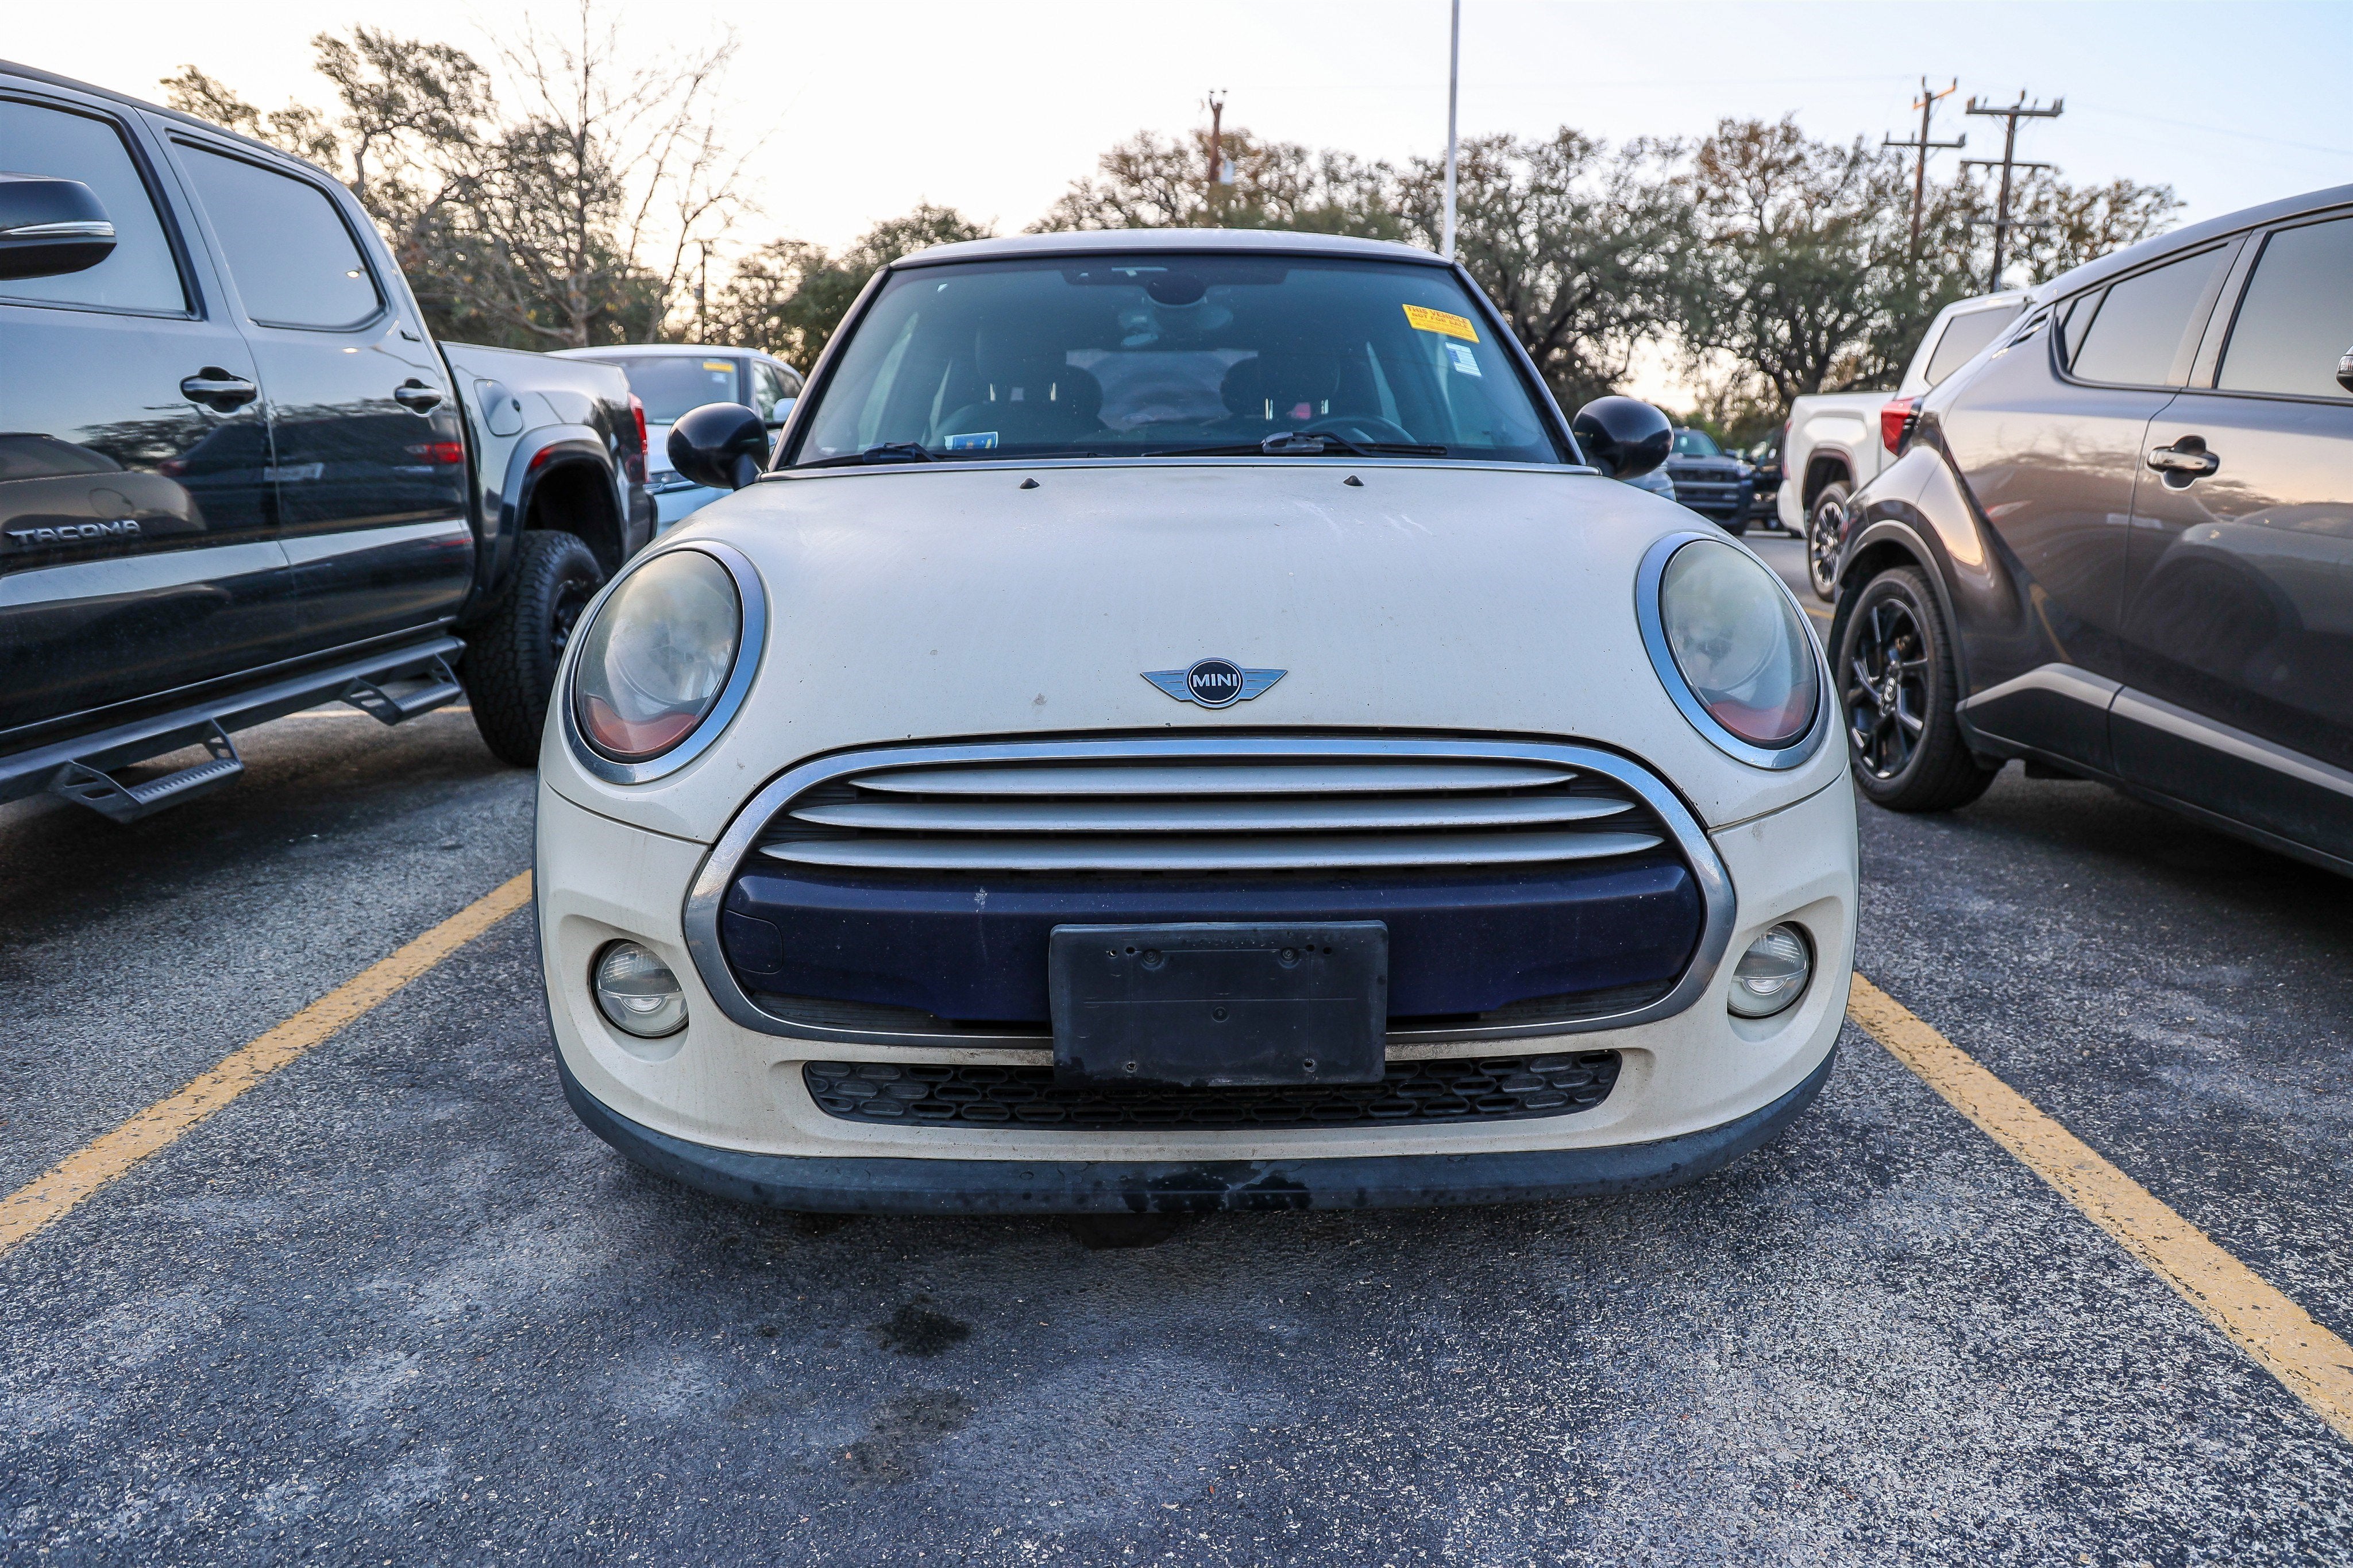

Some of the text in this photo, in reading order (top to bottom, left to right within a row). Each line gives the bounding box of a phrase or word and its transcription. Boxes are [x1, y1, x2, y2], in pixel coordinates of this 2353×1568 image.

[1406, 306, 1468, 324] THIS VEHICLE
[1449, 320, 1468, 329] SALE
[5, 519, 141, 546] TACOMA
[1193, 673, 1237, 687] MINI
